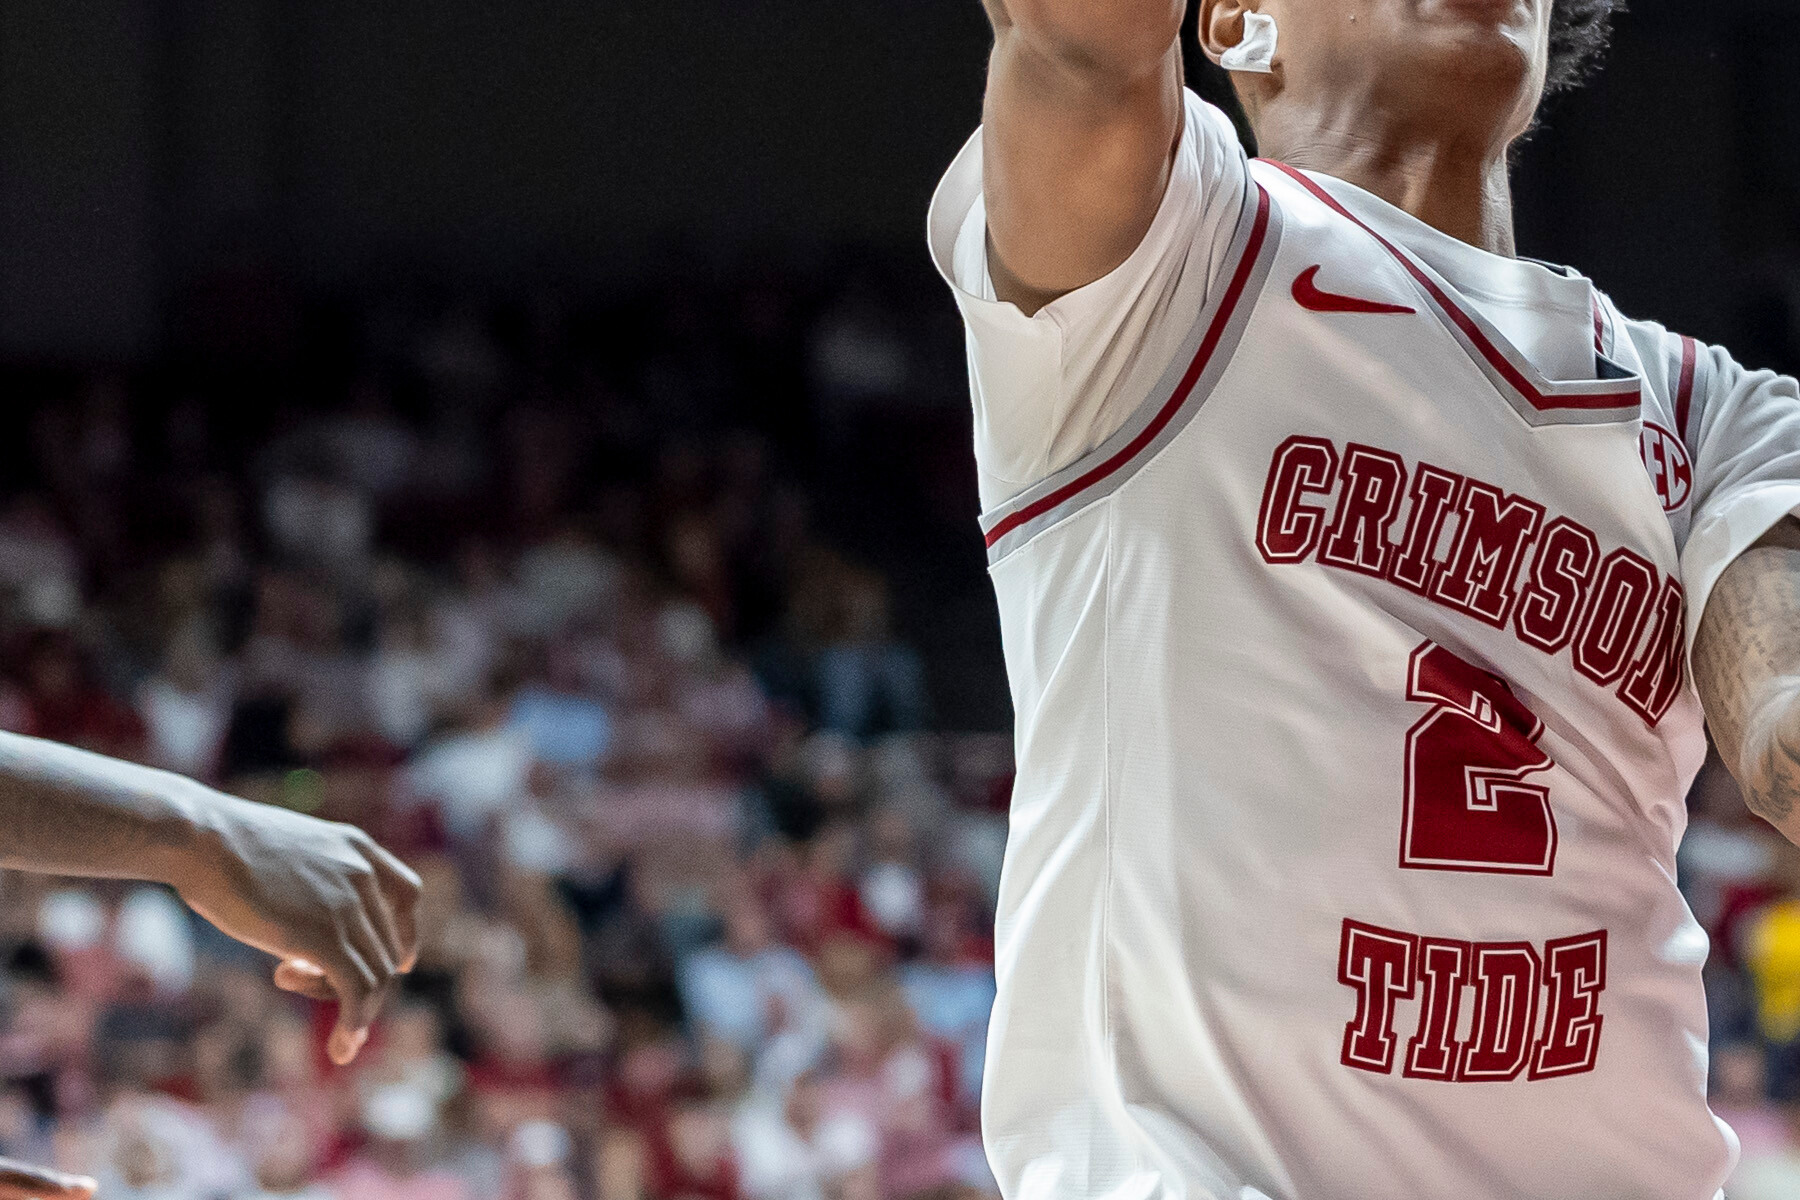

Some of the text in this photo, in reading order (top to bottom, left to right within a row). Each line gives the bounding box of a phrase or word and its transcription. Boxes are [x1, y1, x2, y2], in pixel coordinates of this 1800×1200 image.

[1642, 427, 1687, 507] EC
[1255, 435, 1686, 728] CRIMSON
[1399, 638, 1557, 877] 2
[1338, 918, 1607, 1082] TIDE
